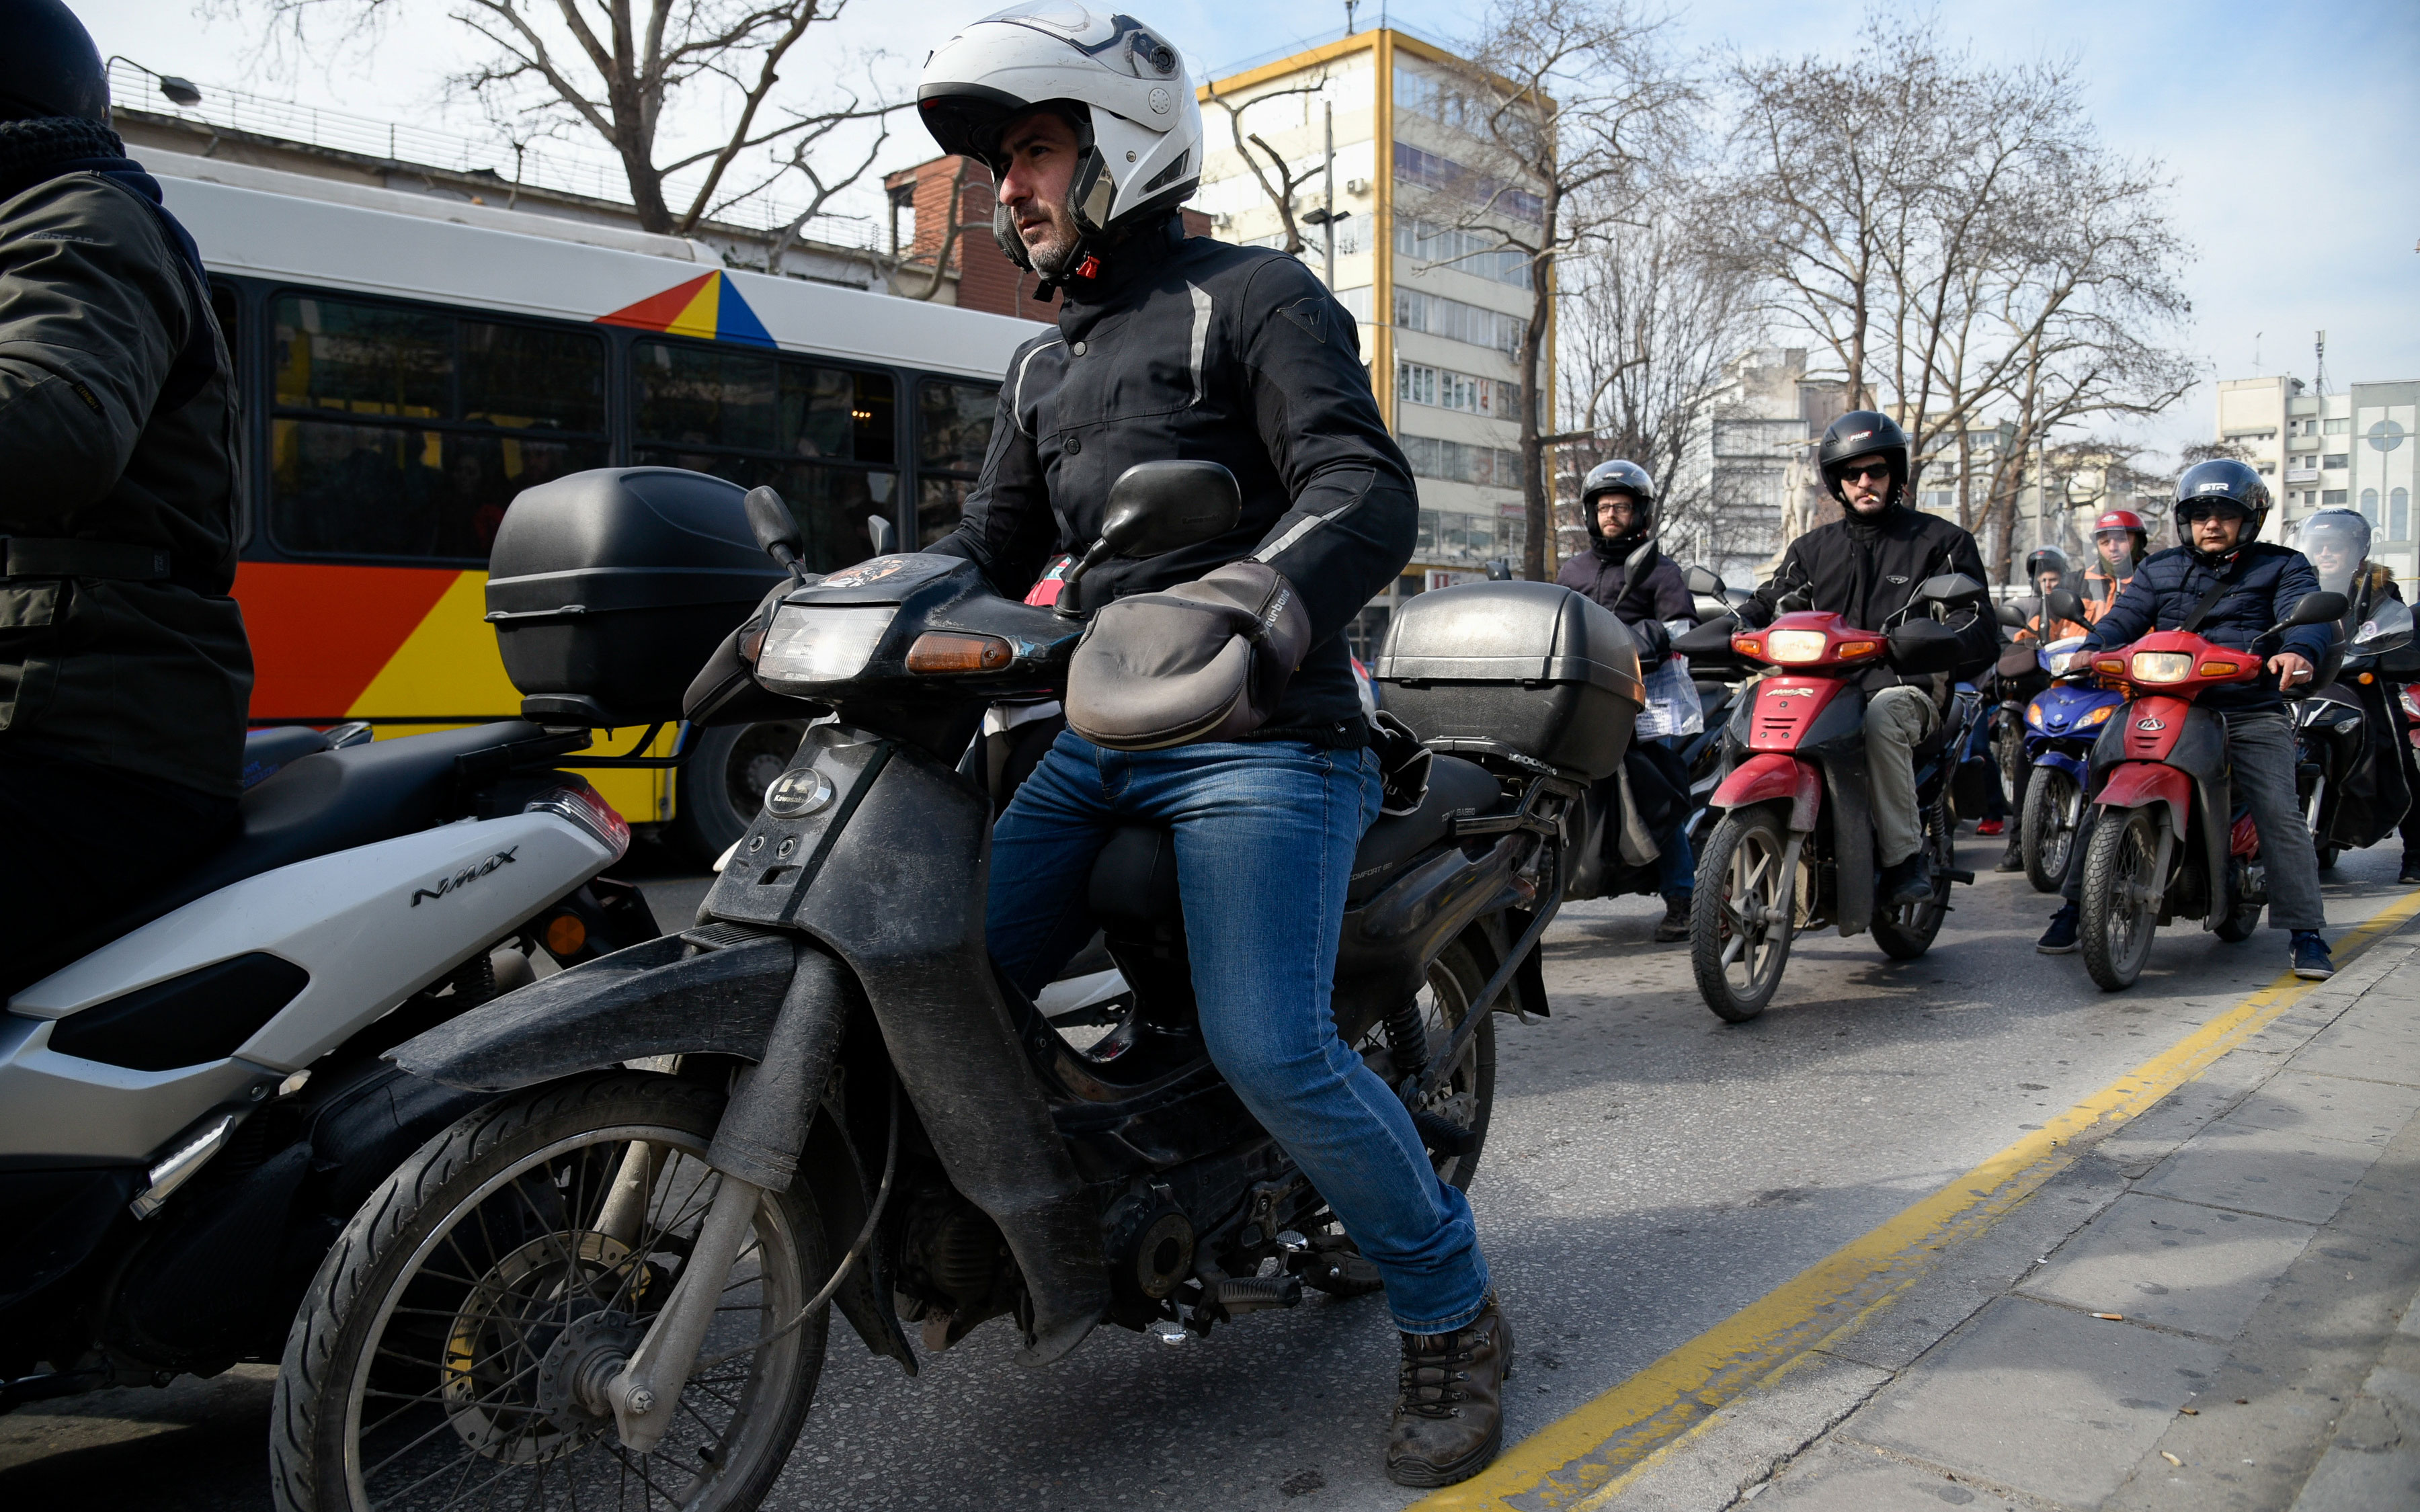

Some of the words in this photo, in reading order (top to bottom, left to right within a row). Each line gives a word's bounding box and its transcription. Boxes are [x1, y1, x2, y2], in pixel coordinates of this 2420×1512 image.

[2200, 482, 2229, 491] STR
[774, 794, 807, 804] Kawasaki
[411, 845, 519, 907] NMAX
[1348, 866, 1382, 882] COMFORT
